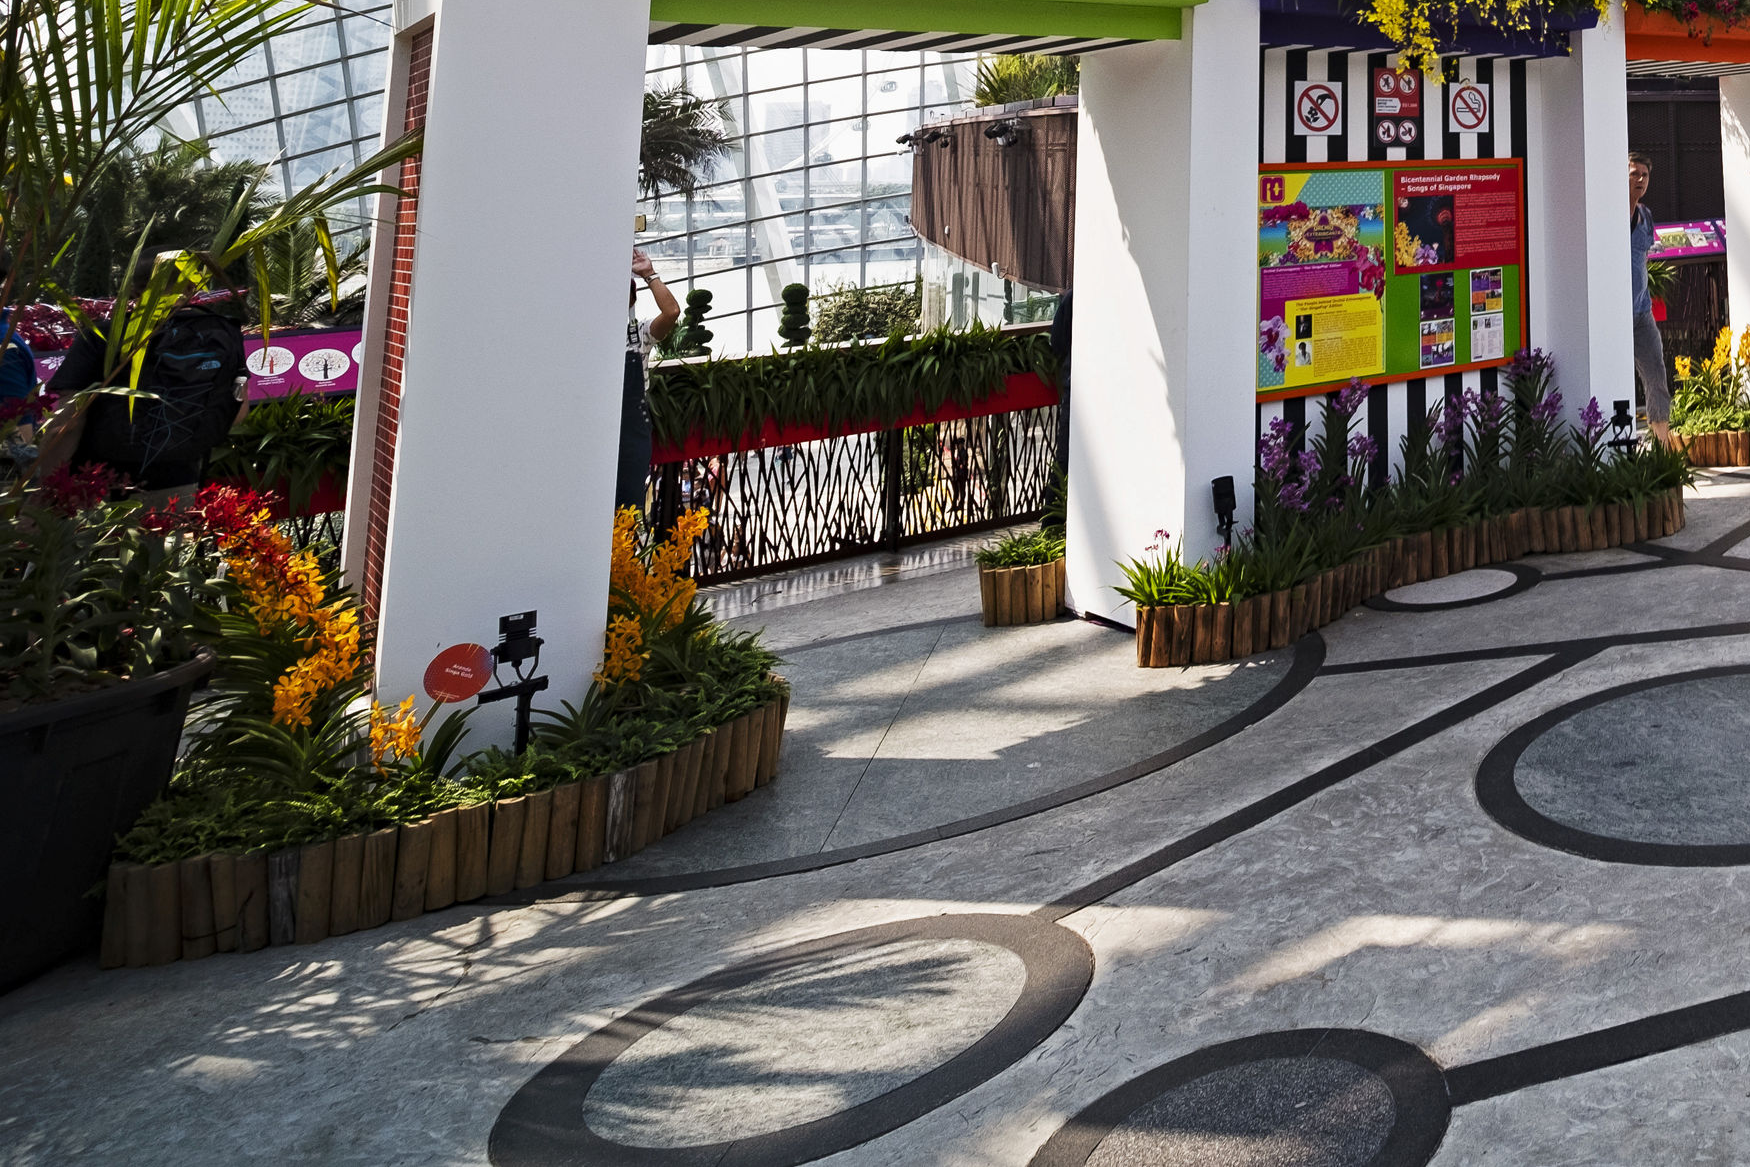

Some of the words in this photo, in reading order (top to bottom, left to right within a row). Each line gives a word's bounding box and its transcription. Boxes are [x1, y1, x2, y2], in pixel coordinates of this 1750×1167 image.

[1400, 175, 1443, 184] Bicentennial
[1444, 174, 1468, 182] Garden
[1469, 173, 1501, 183] Rhapsody
[1407, 185, 1428, 193] Songs
[1438, 183, 1472, 192] Singapore
